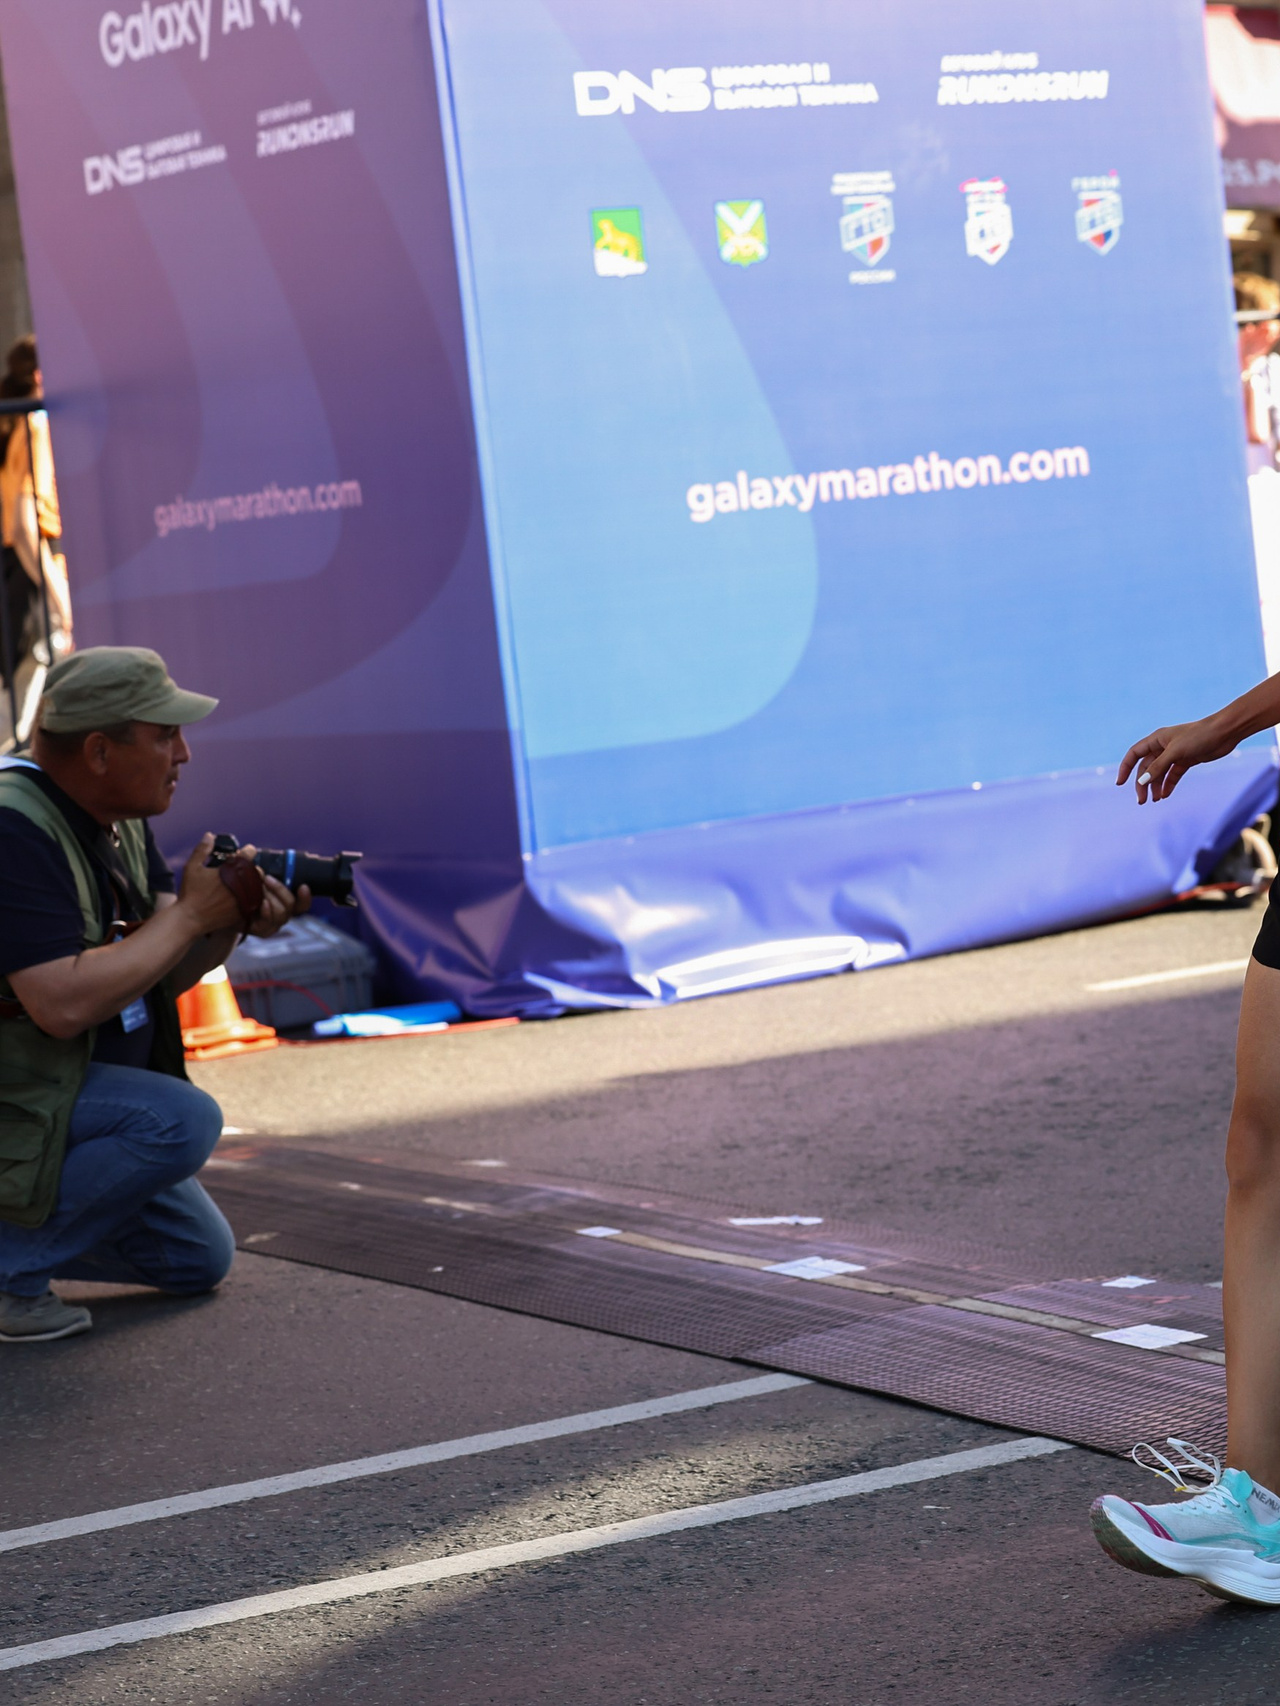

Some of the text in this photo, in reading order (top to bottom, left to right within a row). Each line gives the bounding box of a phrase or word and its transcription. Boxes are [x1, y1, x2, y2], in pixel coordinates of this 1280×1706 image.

[100, 0, 211, 66] Galaxy
[573, 68, 712, 115] DNS
[83, 147, 146, 195] DNS
[153, 479, 363, 538] galaxymarathon.com
[686, 446, 1090, 523] galaxymarathon.com
